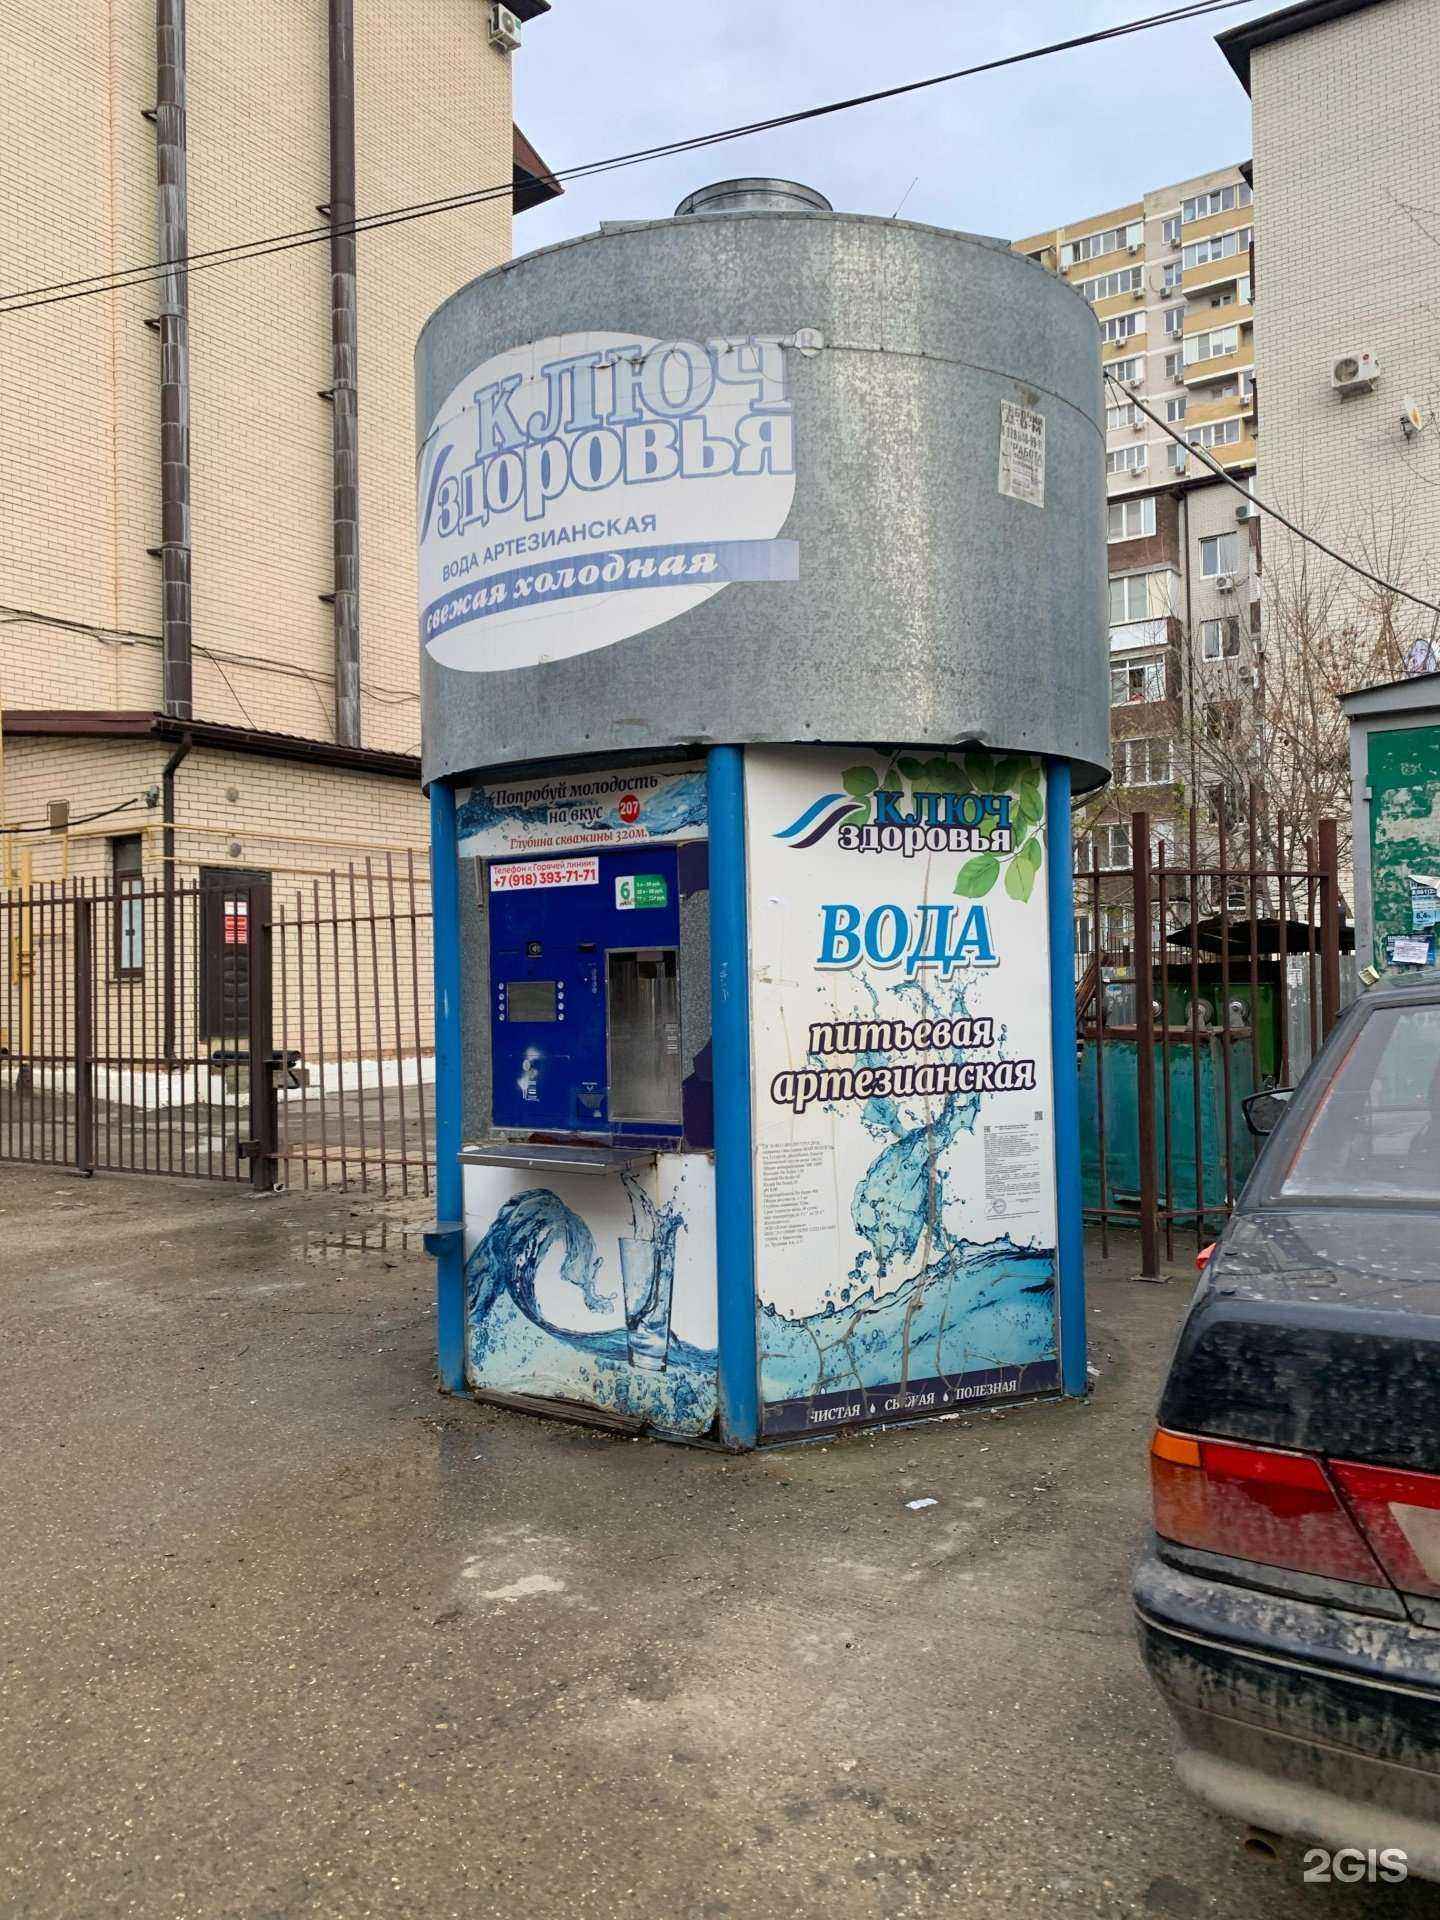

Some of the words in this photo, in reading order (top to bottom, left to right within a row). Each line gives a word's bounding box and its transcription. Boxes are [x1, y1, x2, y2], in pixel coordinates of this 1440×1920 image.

[473, 335, 793, 458] КЛЮЧ
[442, 555, 480, 582] ВОДА
[482, 514, 657, 566] АРТЕЗИАНСКАЯ
[426, 584, 508, 632] свежая
[513, 550, 719, 597] холодная
[569, 775, 659, 796] молодость
[549, 808, 567, 823] на
[570, 806, 603, 825] вкус
[619, 801, 638, 815] 207
[874, 790, 1013, 829] КЛЮЧ
[510, 837, 553, 851] Глубина
[555, 831, 613, 845] скважины
[494, 864, 527, 874] Телефон
[494, 876, 507, 887] +7
[509, 873, 537, 888] (918)
[540, 869, 596, 883] 393-71-71
[621, 881, 630, 900] 6
[815, 904, 999, 982] ВОДА
[809, 1017, 995, 1055] питьевая
[771, 1059, 1037, 1114] артезианская
[955, 1380, 1018, 1400] ПОЛЕЗНАЯ
